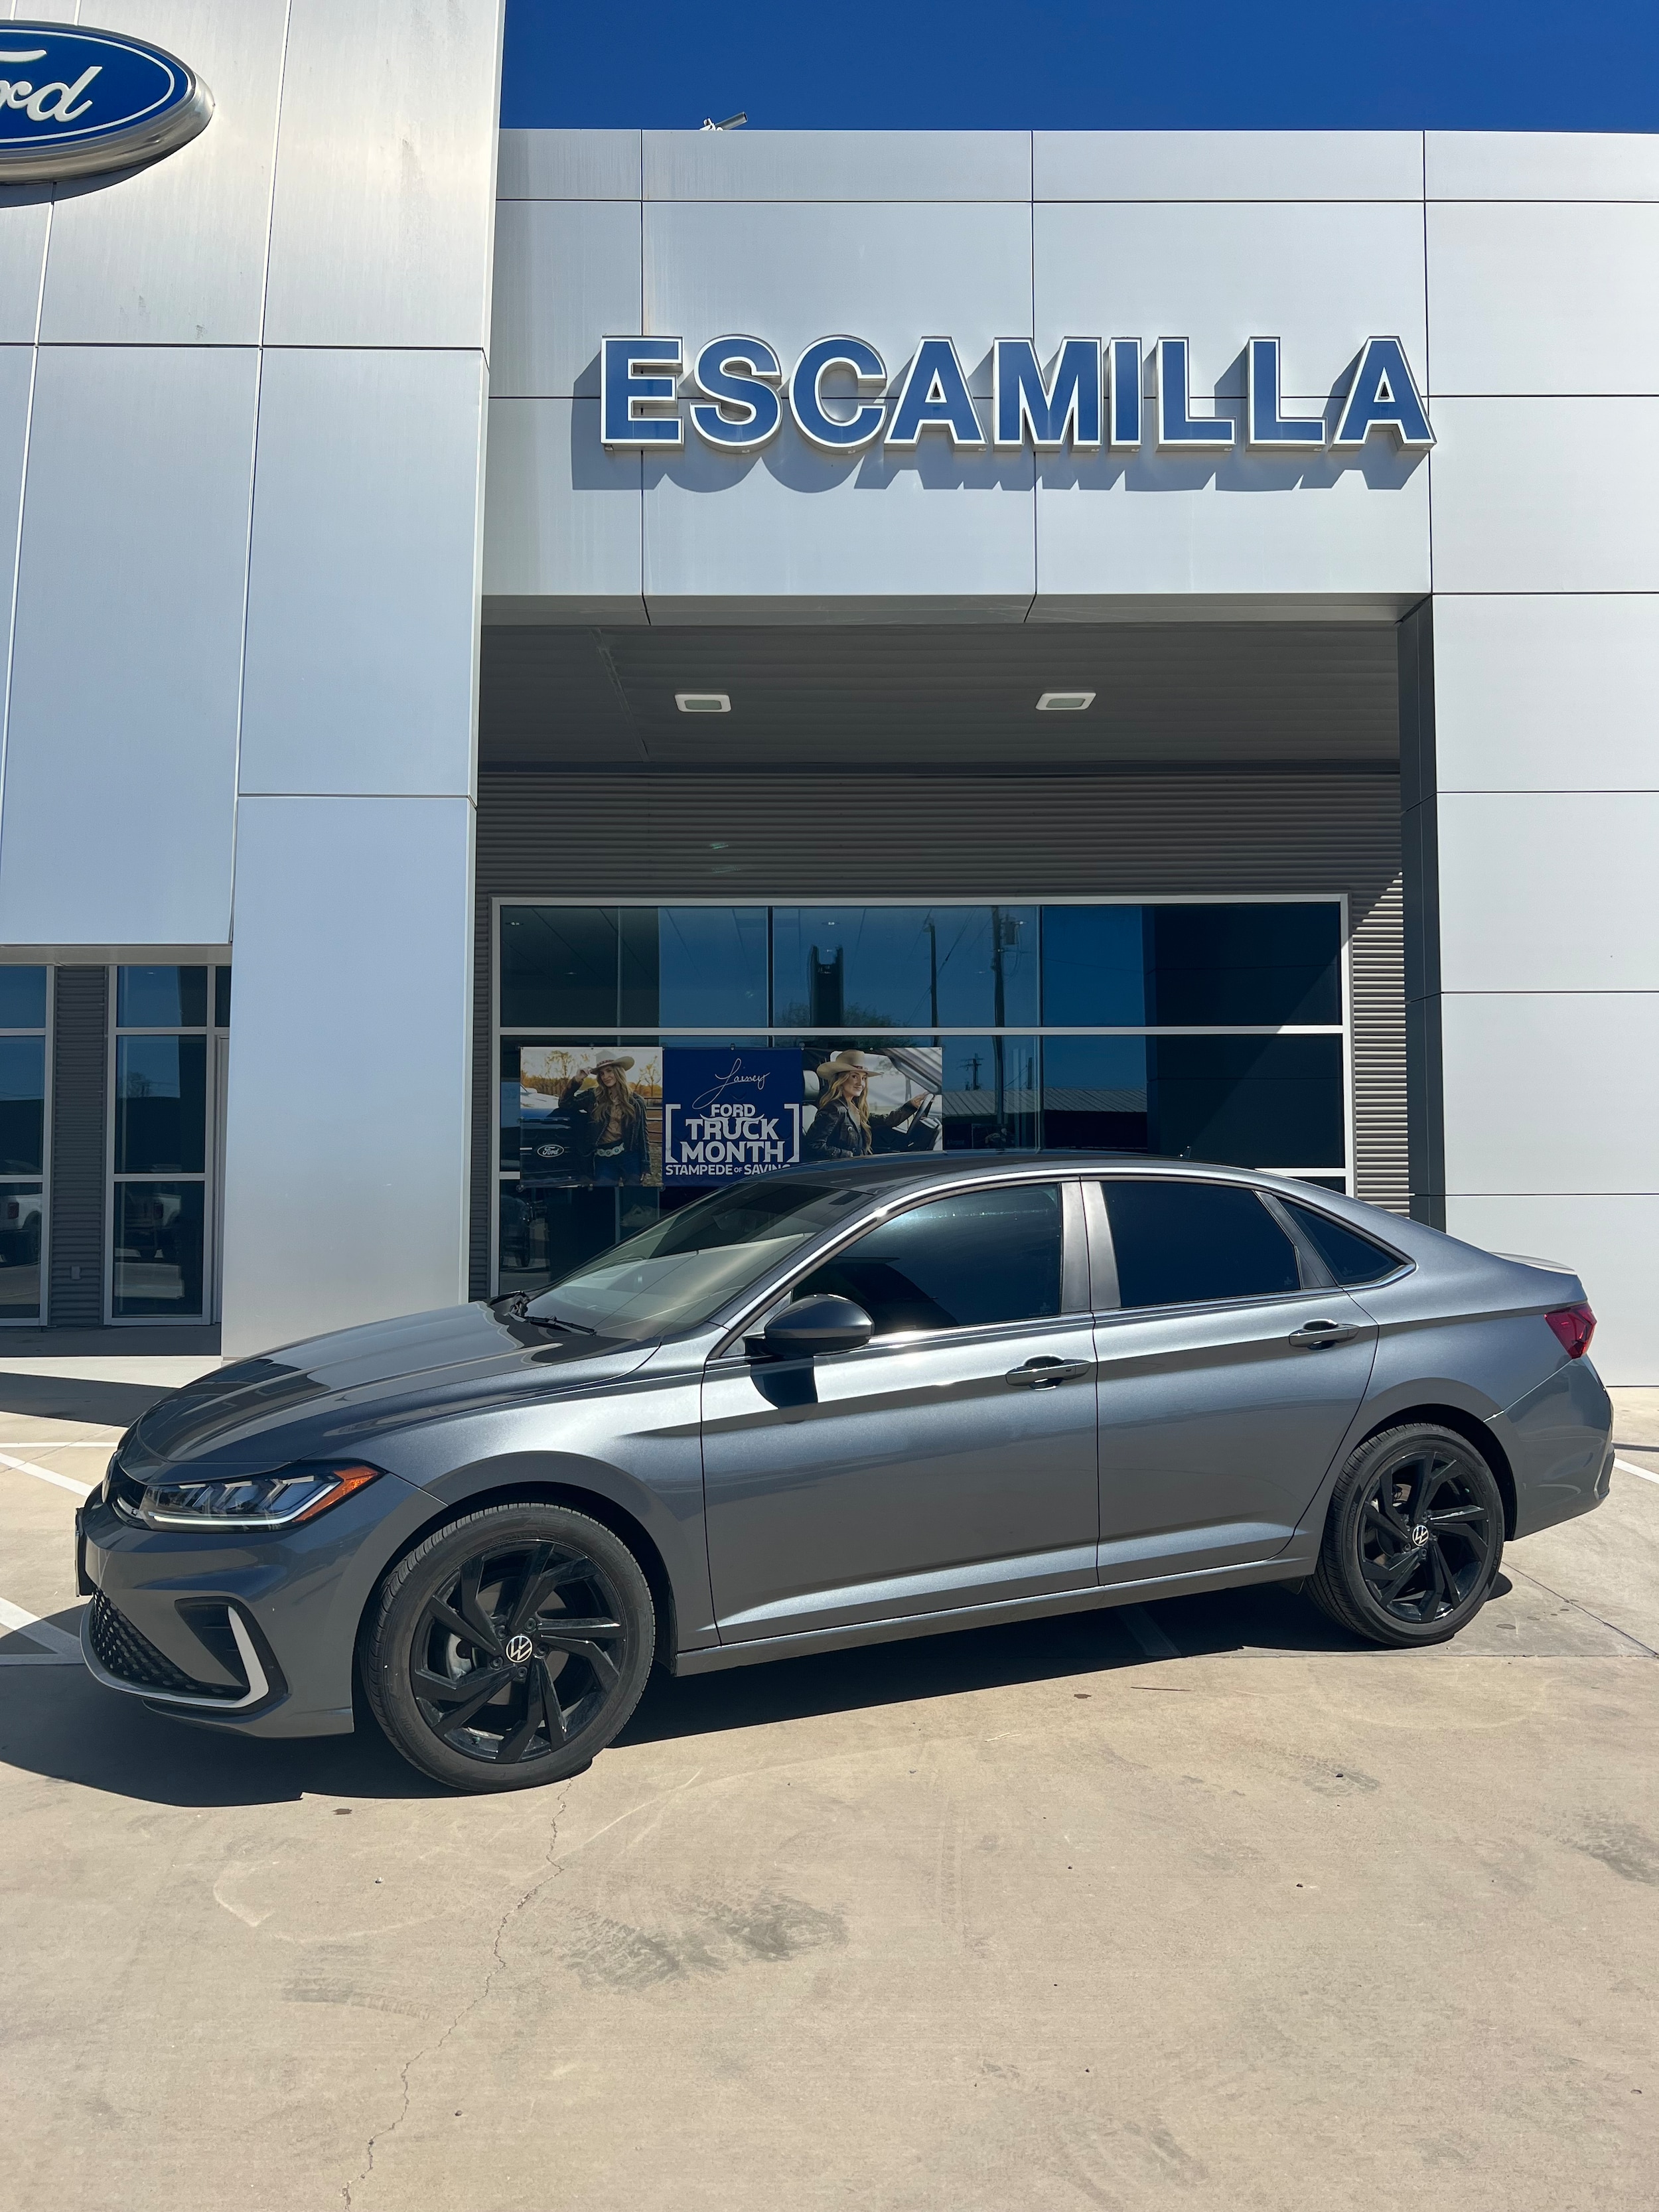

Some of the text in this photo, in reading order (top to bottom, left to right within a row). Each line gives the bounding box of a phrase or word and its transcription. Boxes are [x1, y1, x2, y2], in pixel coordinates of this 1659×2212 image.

[600, 334, 1437, 451] ESCAMILLA
[710, 1104, 756, 1118] FORD
[685, 1114, 780, 1140] TRUCK
[542, 1145, 560, 1155] Ford
[680, 1141, 786, 1163] MONTH
[666, 1164, 733, 1175] STAMPEDE
